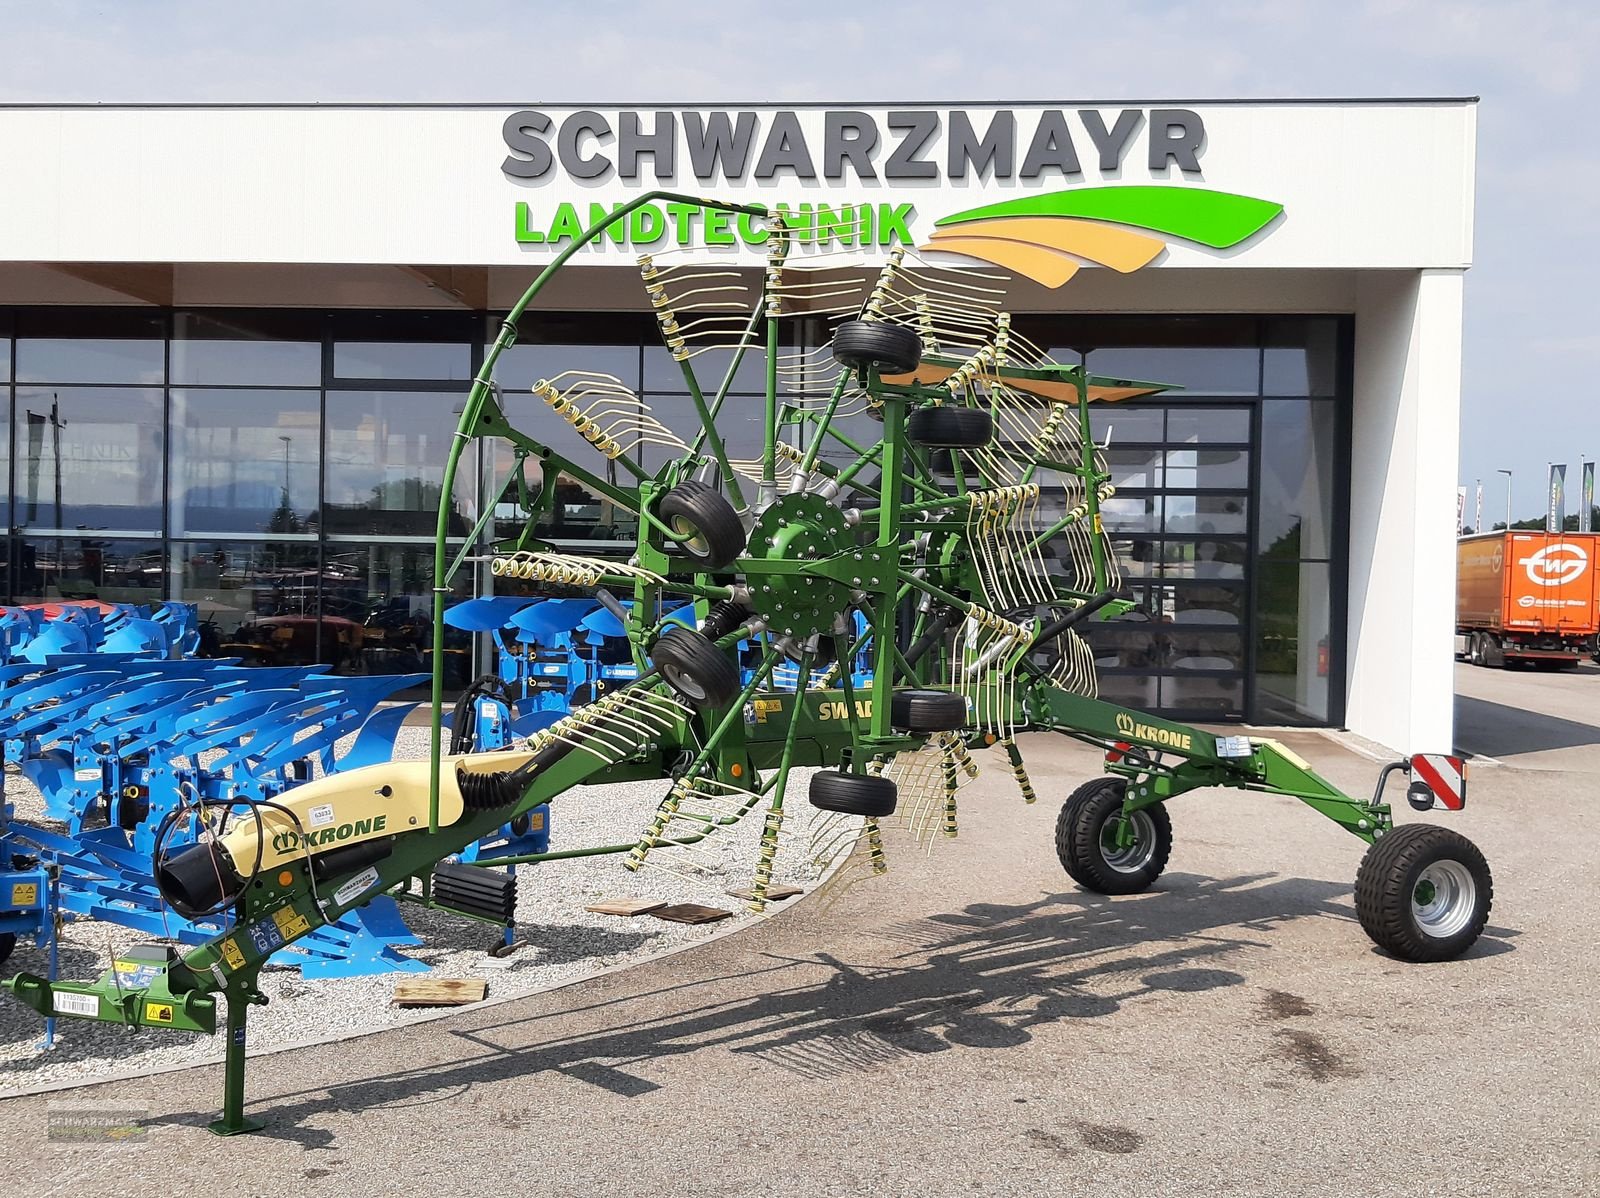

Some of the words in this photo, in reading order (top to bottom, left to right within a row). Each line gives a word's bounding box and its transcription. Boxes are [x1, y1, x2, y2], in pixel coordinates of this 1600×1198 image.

[501, 108, 1208, 179] SCHWARZMAYR
[515, 202, 916, 246] LANDTECHNIK
[1135, 723, 1191, 750] KRONE
[303, 814, 386, 849] KRONE
